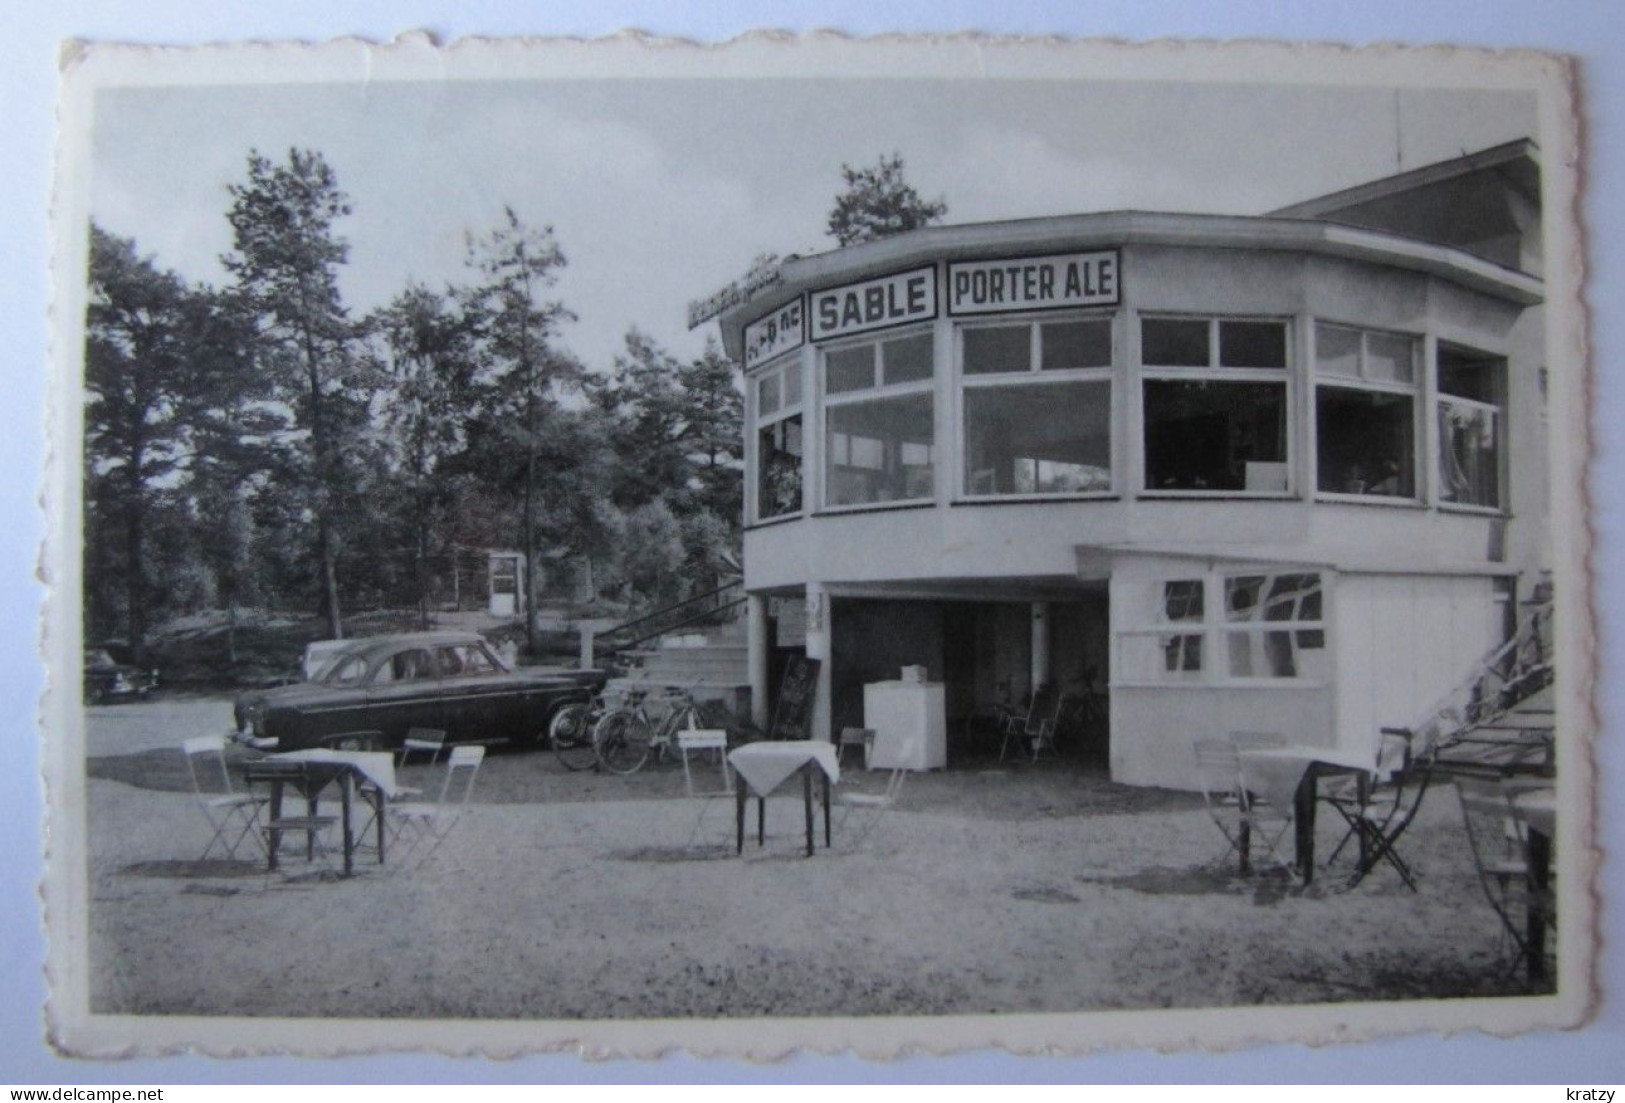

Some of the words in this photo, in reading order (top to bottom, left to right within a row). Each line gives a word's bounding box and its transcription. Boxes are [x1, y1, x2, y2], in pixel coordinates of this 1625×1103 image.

[819, 277, 925, 331] SABLE
[955, 263, 1054, 305] PORTER
[1064, 260, 1112, 298] ALE
